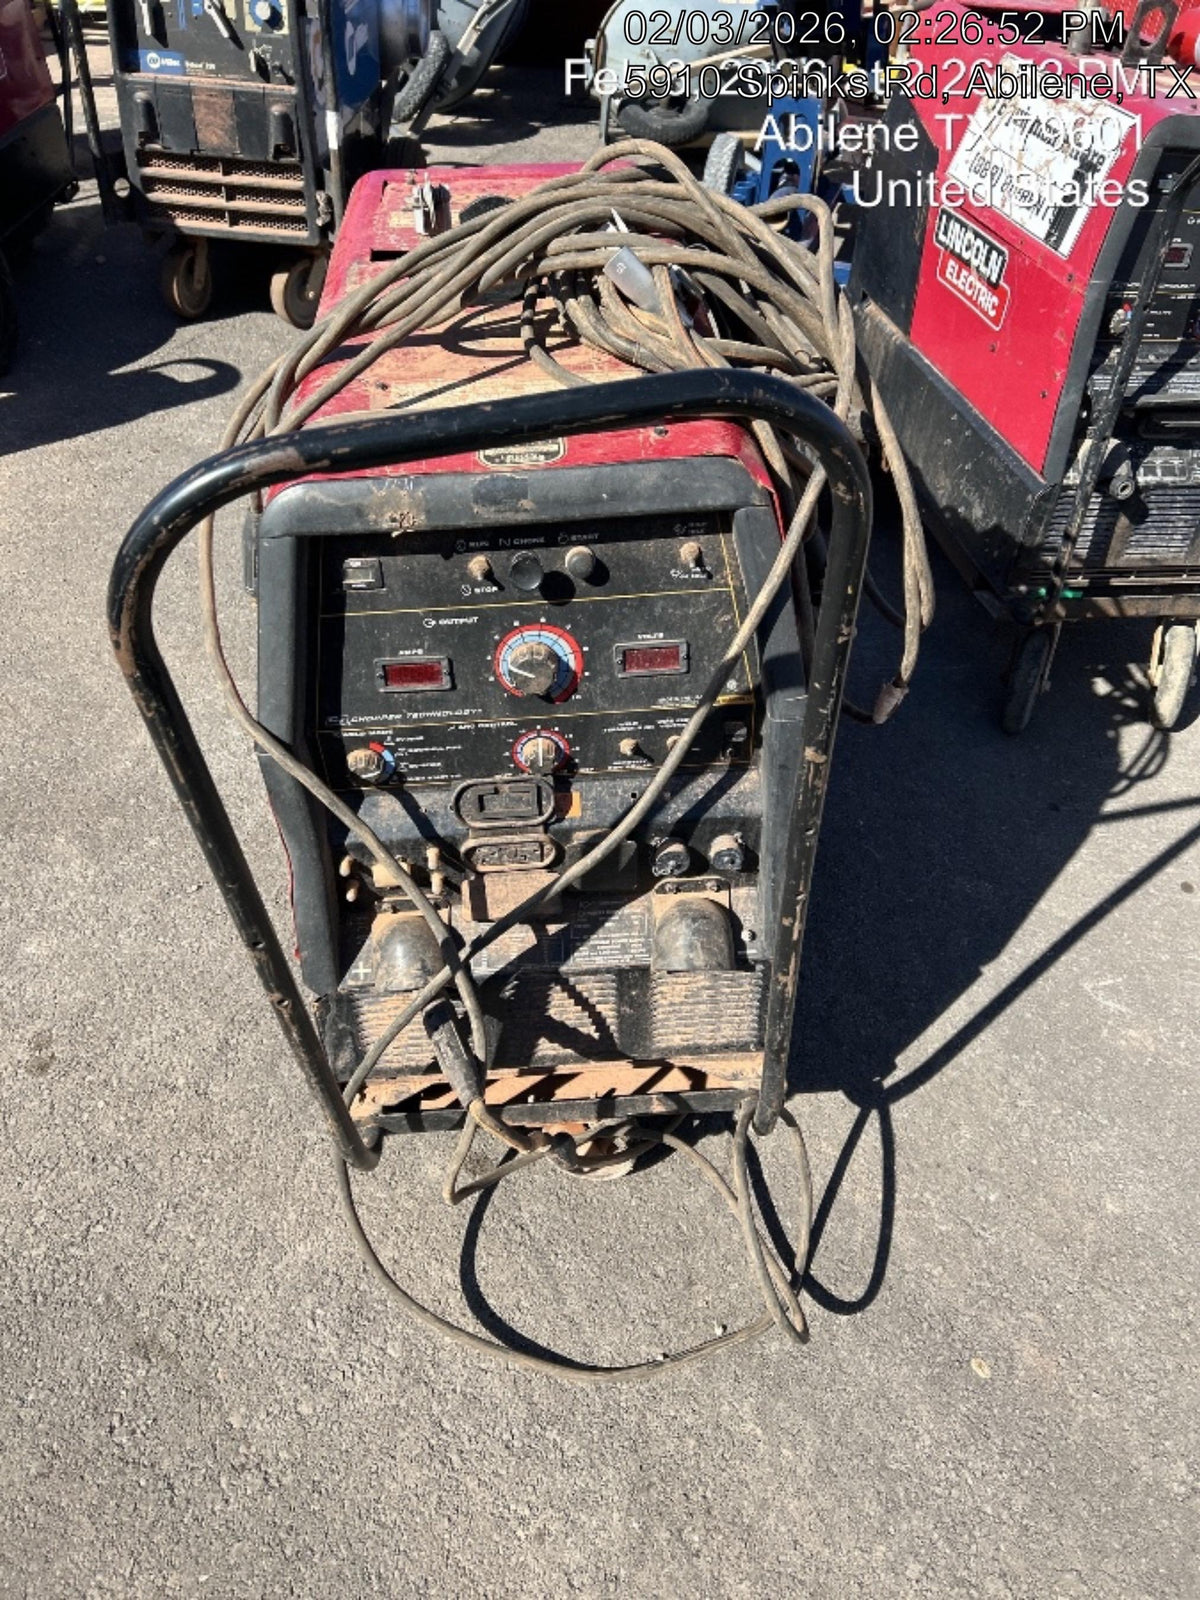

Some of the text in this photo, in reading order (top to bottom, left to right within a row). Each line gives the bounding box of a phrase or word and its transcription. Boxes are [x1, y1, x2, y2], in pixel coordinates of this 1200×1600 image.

[938, 214, 1004, 284] LINCOLN
[945, 258, 999, 318] ELECTRIC
[438, 616, 480, 625] OUTPUT
